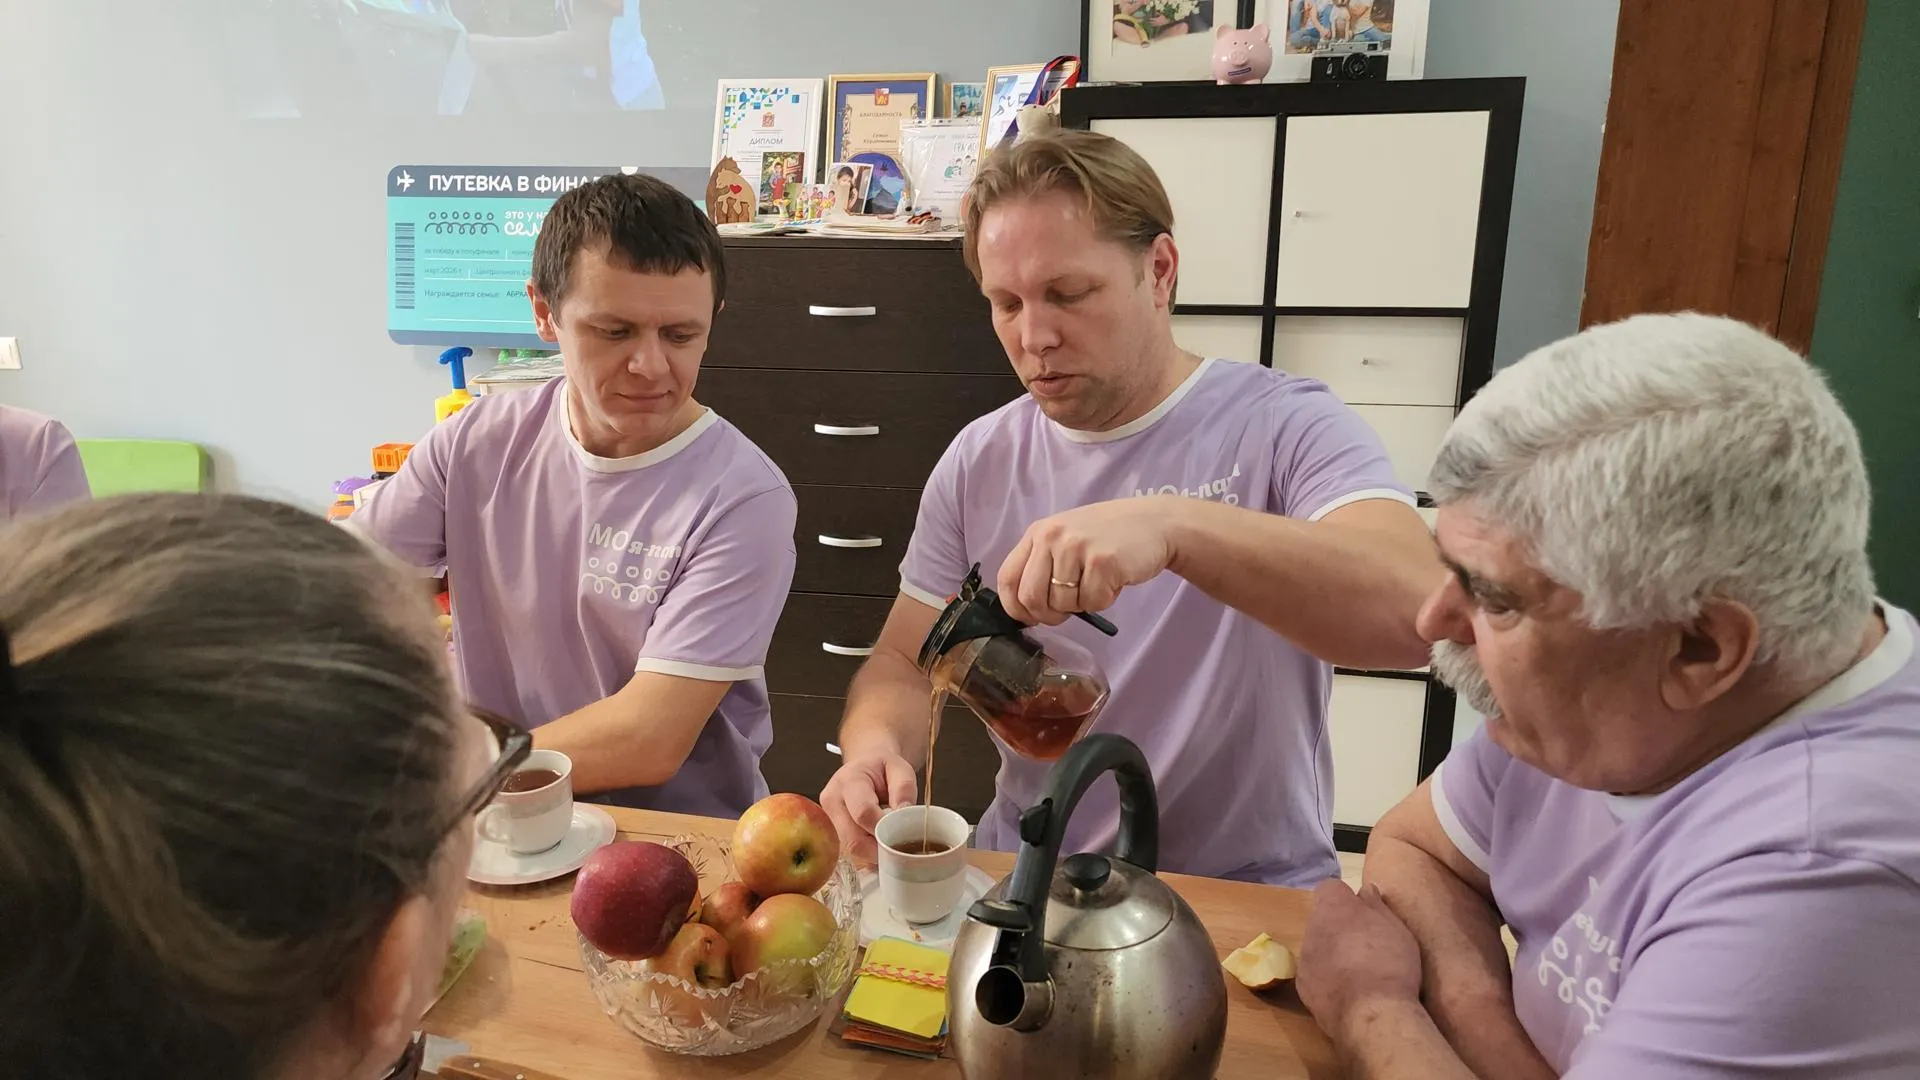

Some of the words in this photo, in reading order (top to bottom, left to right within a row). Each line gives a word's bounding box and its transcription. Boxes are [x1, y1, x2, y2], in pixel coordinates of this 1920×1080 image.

[749, 138, 784, 146] ДИПЛОМ
[429, 174, 513, 192] ПУТЕВКА
[517, 175, 530, 192] В
[534, 174, 601, 193] ФИНА
[504, 210, 524, 220] это
[527, 211, 534, 222] у
